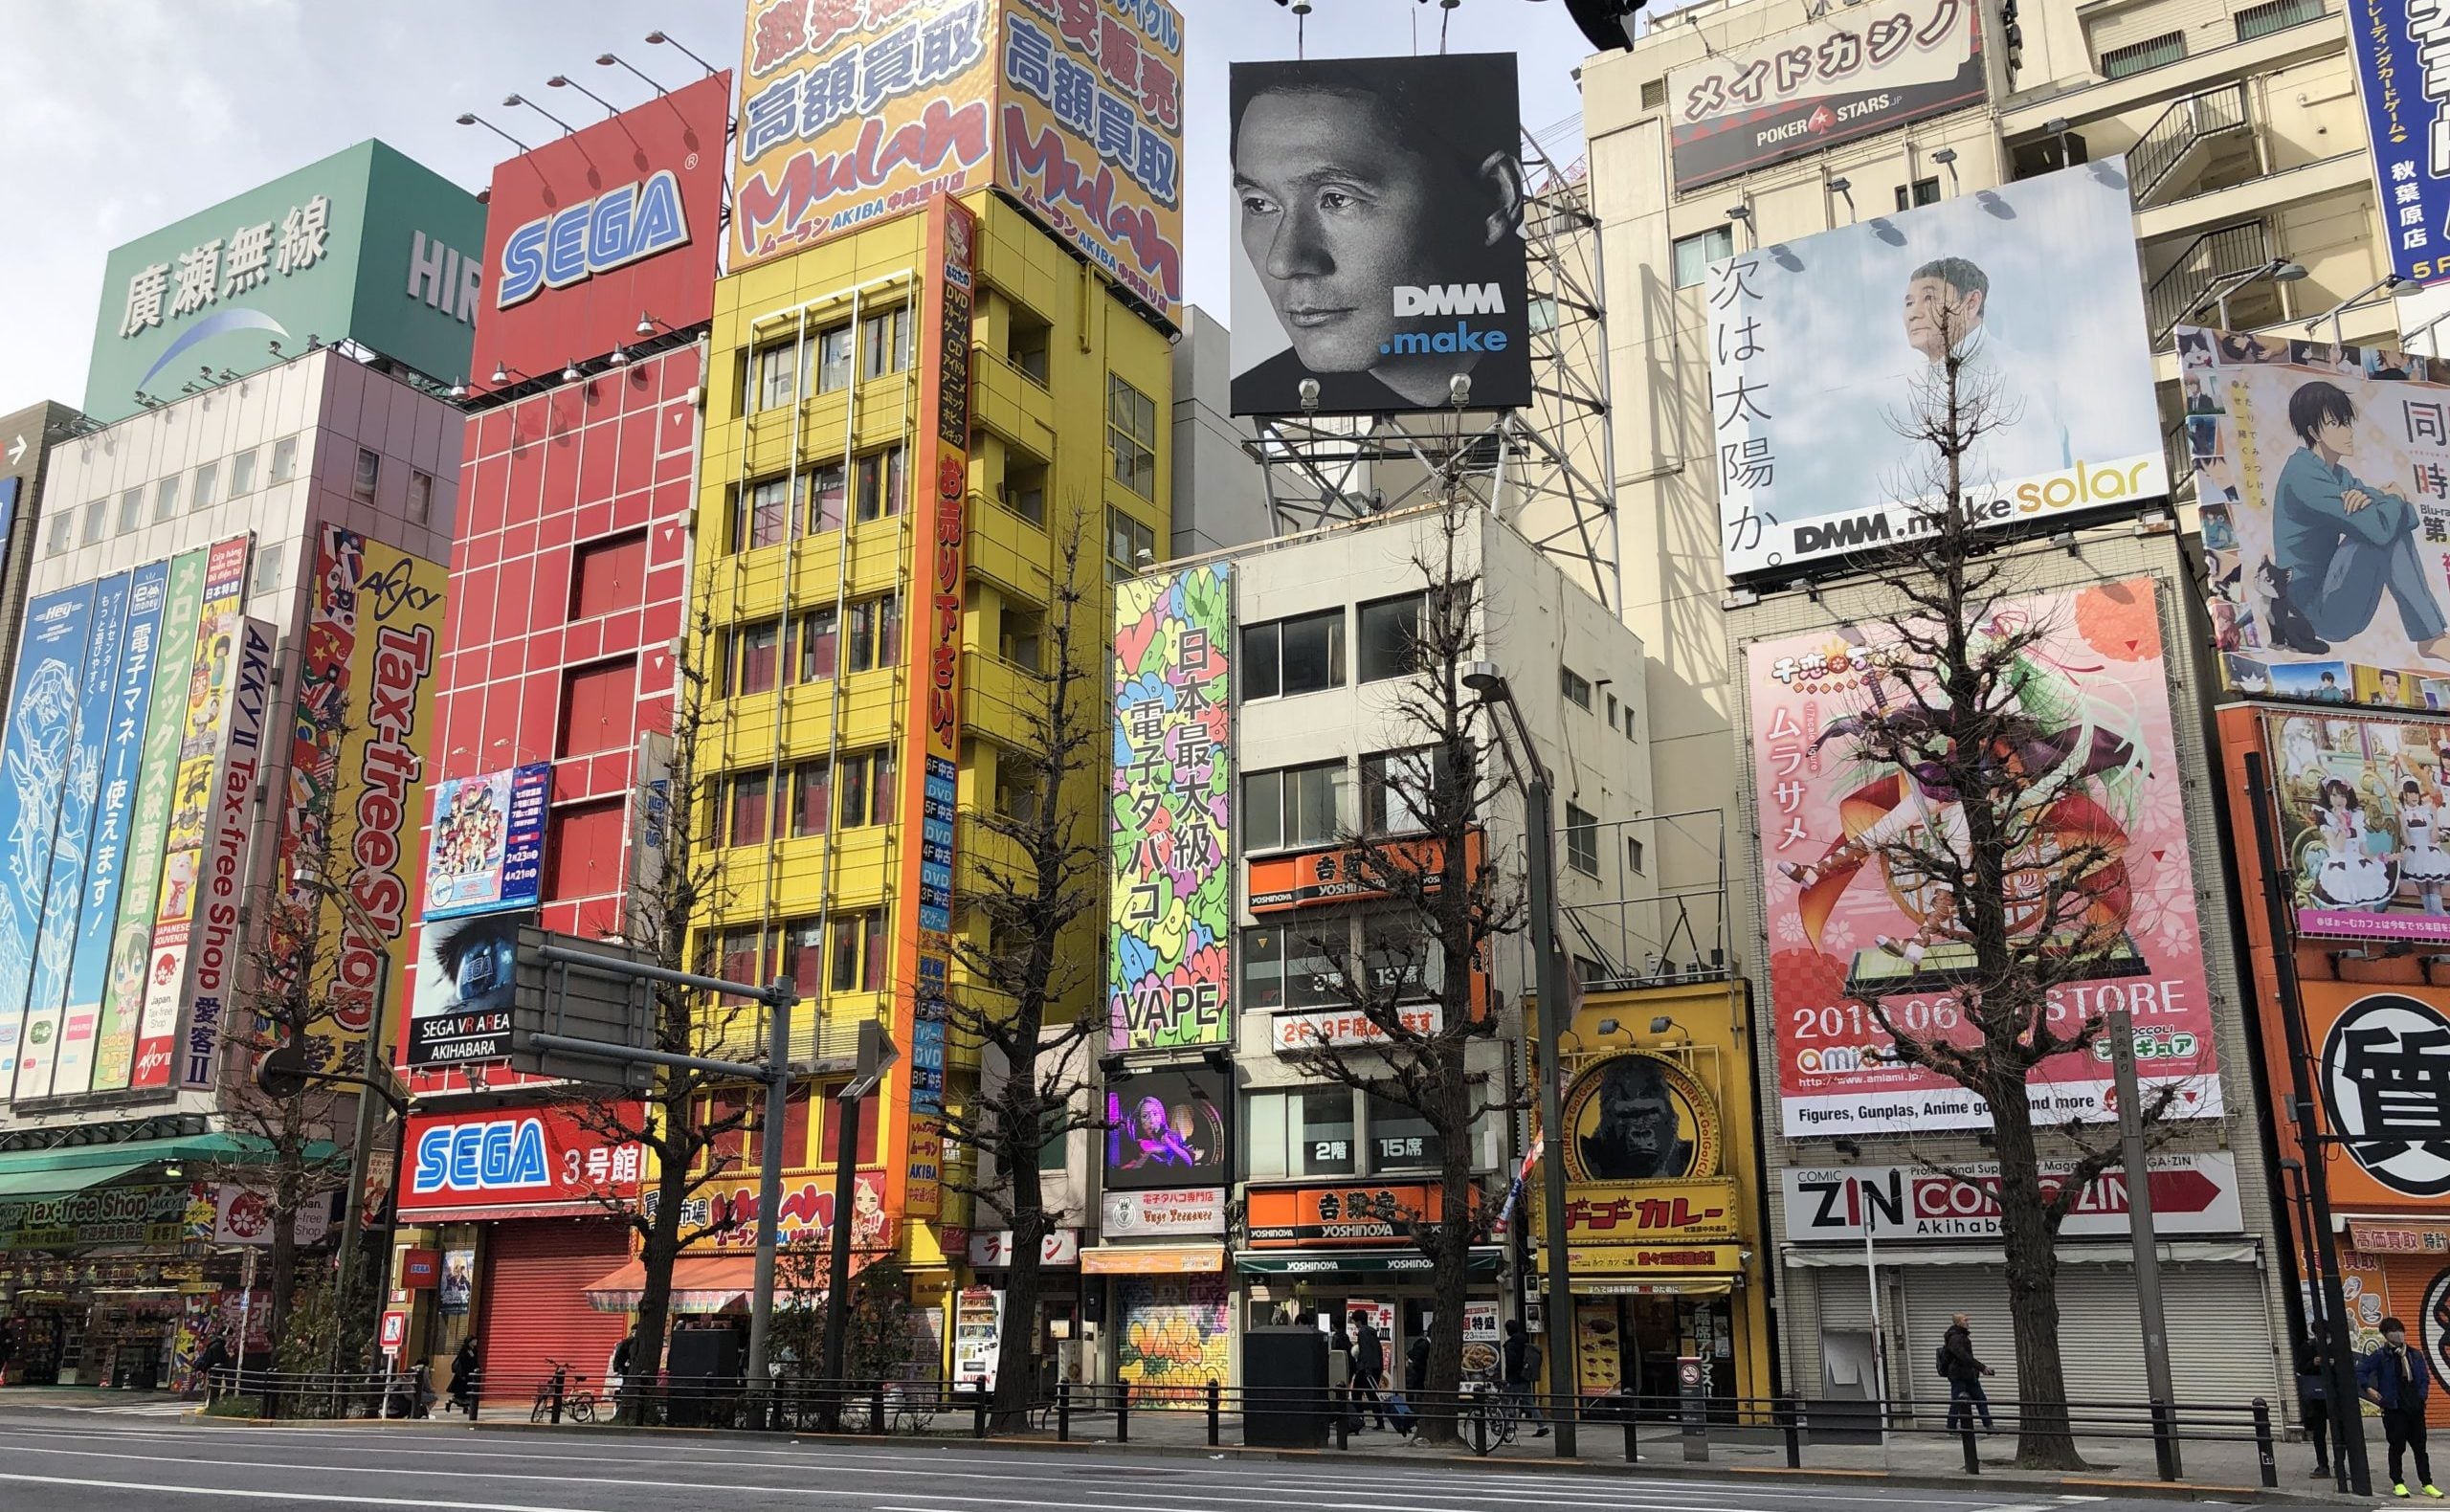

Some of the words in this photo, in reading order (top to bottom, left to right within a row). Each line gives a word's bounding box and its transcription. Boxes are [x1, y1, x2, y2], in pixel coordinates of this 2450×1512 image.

[1026, 0, 1176, 124] 安販売
[1684, 0, 1959, 122] メイドカジノ
[2368, 0, 2406, 135] レーディングカードゲーム
[743, 5, 983, 159] 高額買取
[1007, 16, 1176, 198] 高額買取
[1756, 121, 1808, 147] POKER
[739, 99, 990, 256] Mulan
[1003, 104, 1181, 300] Mulan
[2392, 160, 2429, 251] 秋葉原店
[497, 169, 693, 311] SEGA
[119, 194, 331, 339] 廣瀬無線
[946, 284, 969, 309] DVD
[1393, 282, 1506, 318] DMM
[944, 319, 968, 345] ゲーム
[1380, 321, 1508, 355] .make
[947, 338, 963, 358] CD
[943, 353, 967, 377] アイドル
[942, 371, 967, 394] アニメ
[942, 389, 965, 411] コミック
[1709, 256, 1783, 568] 次は太陽か。
[943, 407, 963, 427] ホビー
[1794, 496, 2012, 556] DMM.mke
[2017, 460, 2149, 513] solar
[357, 558, 442, 620] AKKY
[45, 602, 73, 621] Hey
[99, 590, 122, 692] ゲームセンターを
[241, 623, 271, 727] AKKY
[127, 561, 198, 916] メロンブックス秋葉原店
[356, 627, 430, 865] Tax-free
[1170, 627, 1214, 871] 日本最大級
[927, 784, 952, 802] DVD
[1768, 709, 1808, 851] ムラサメ
[1128, 696, 1166, 921] 電子タバコ
[218, 756, 256, 898] Tax-free
[925, 826, 951, 845] DVD
[924, 869, 948, 888] DVD
[1251, 893, 1293, 905] YOSHINOYA
[153, 932, 189, 946] SOUVENIR
[156, 923, 191, 937] JAPANESE
[198, 903, 238, 988] Shop
[1119, 982, 1220, 1032] VAPE
[423, 1018, 455, 1036] SEGA
[457, 1016, 474, 1034] VR
[476, 1013, 510, 1034] AREA
[2130, 1023, 2174, 1035] OCCOLI
[431, 1040, 497, 1059] AKIHABARA
[914, 1049, 942, 1066] DVD
[1797, 1105, 1855, 1124] Figures,
[1858, 1102, 1920, 1120] Gunplas,
[1923, 1100, 1969, 1117] Anime
[2055, 1095, 2095, 1109] more
[412, 1116, 551, 1195] SEGA
[1315, 1140, 1348, 1162] 2階
[1379, 1137, 1424, 1158] 15席
[562, 1146, 640, 1185] 3号館
[909, 1163, 937, 1180] AKIBA
[1797, 1169, 1842, 1183] COMIC
[28, 1196, 99, 1224] Tax-free
[101, 1190, 148, 1222] Shop
[1798, 1167, 1905, 1233] ZIN
[294, 1224, 322, 1236] Shop
[1250, 1229, 1294, 1238] YOSHINOYA
[1322, 1223, 1394, 1238] YOSHINOYA
[1916, 1217, 1998, 1234] Akihab
[983, 1235, 1063, 1262] ラーン
[2353, 1228, 2419, 1251] 高価買取
[2422, 1231, 2448, 1250] 時計
[410, 1262, 432, 1275] SEGA
[1286, 1261, 1339, 1272] YOSHINOYA
[1387, 1258, 1435, 1270] YOSHINO
